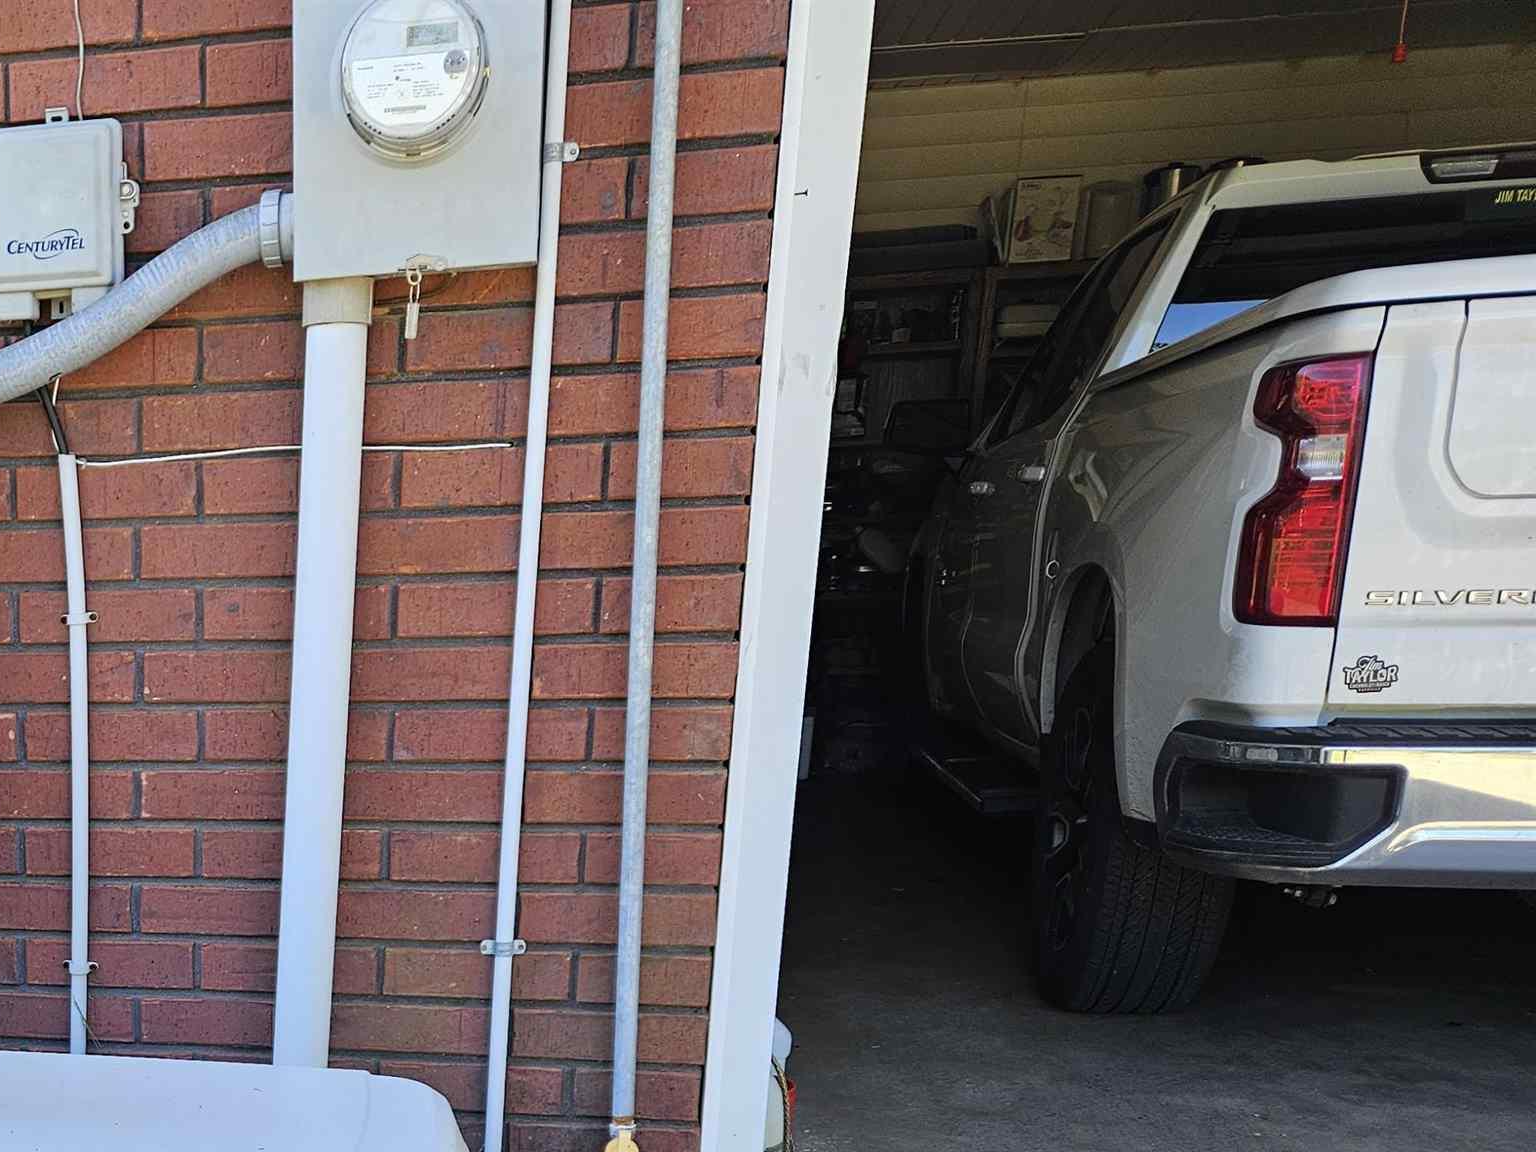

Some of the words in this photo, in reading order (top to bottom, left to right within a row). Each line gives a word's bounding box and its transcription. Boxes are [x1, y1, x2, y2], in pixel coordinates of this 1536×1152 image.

[1495, 190, 1514, 203] JIM
[1516, 188, 1536, 202] TAY
[1364, 588, 1536, 606] SILVER
[1344, 665, 1398, 684] TAYLOR
